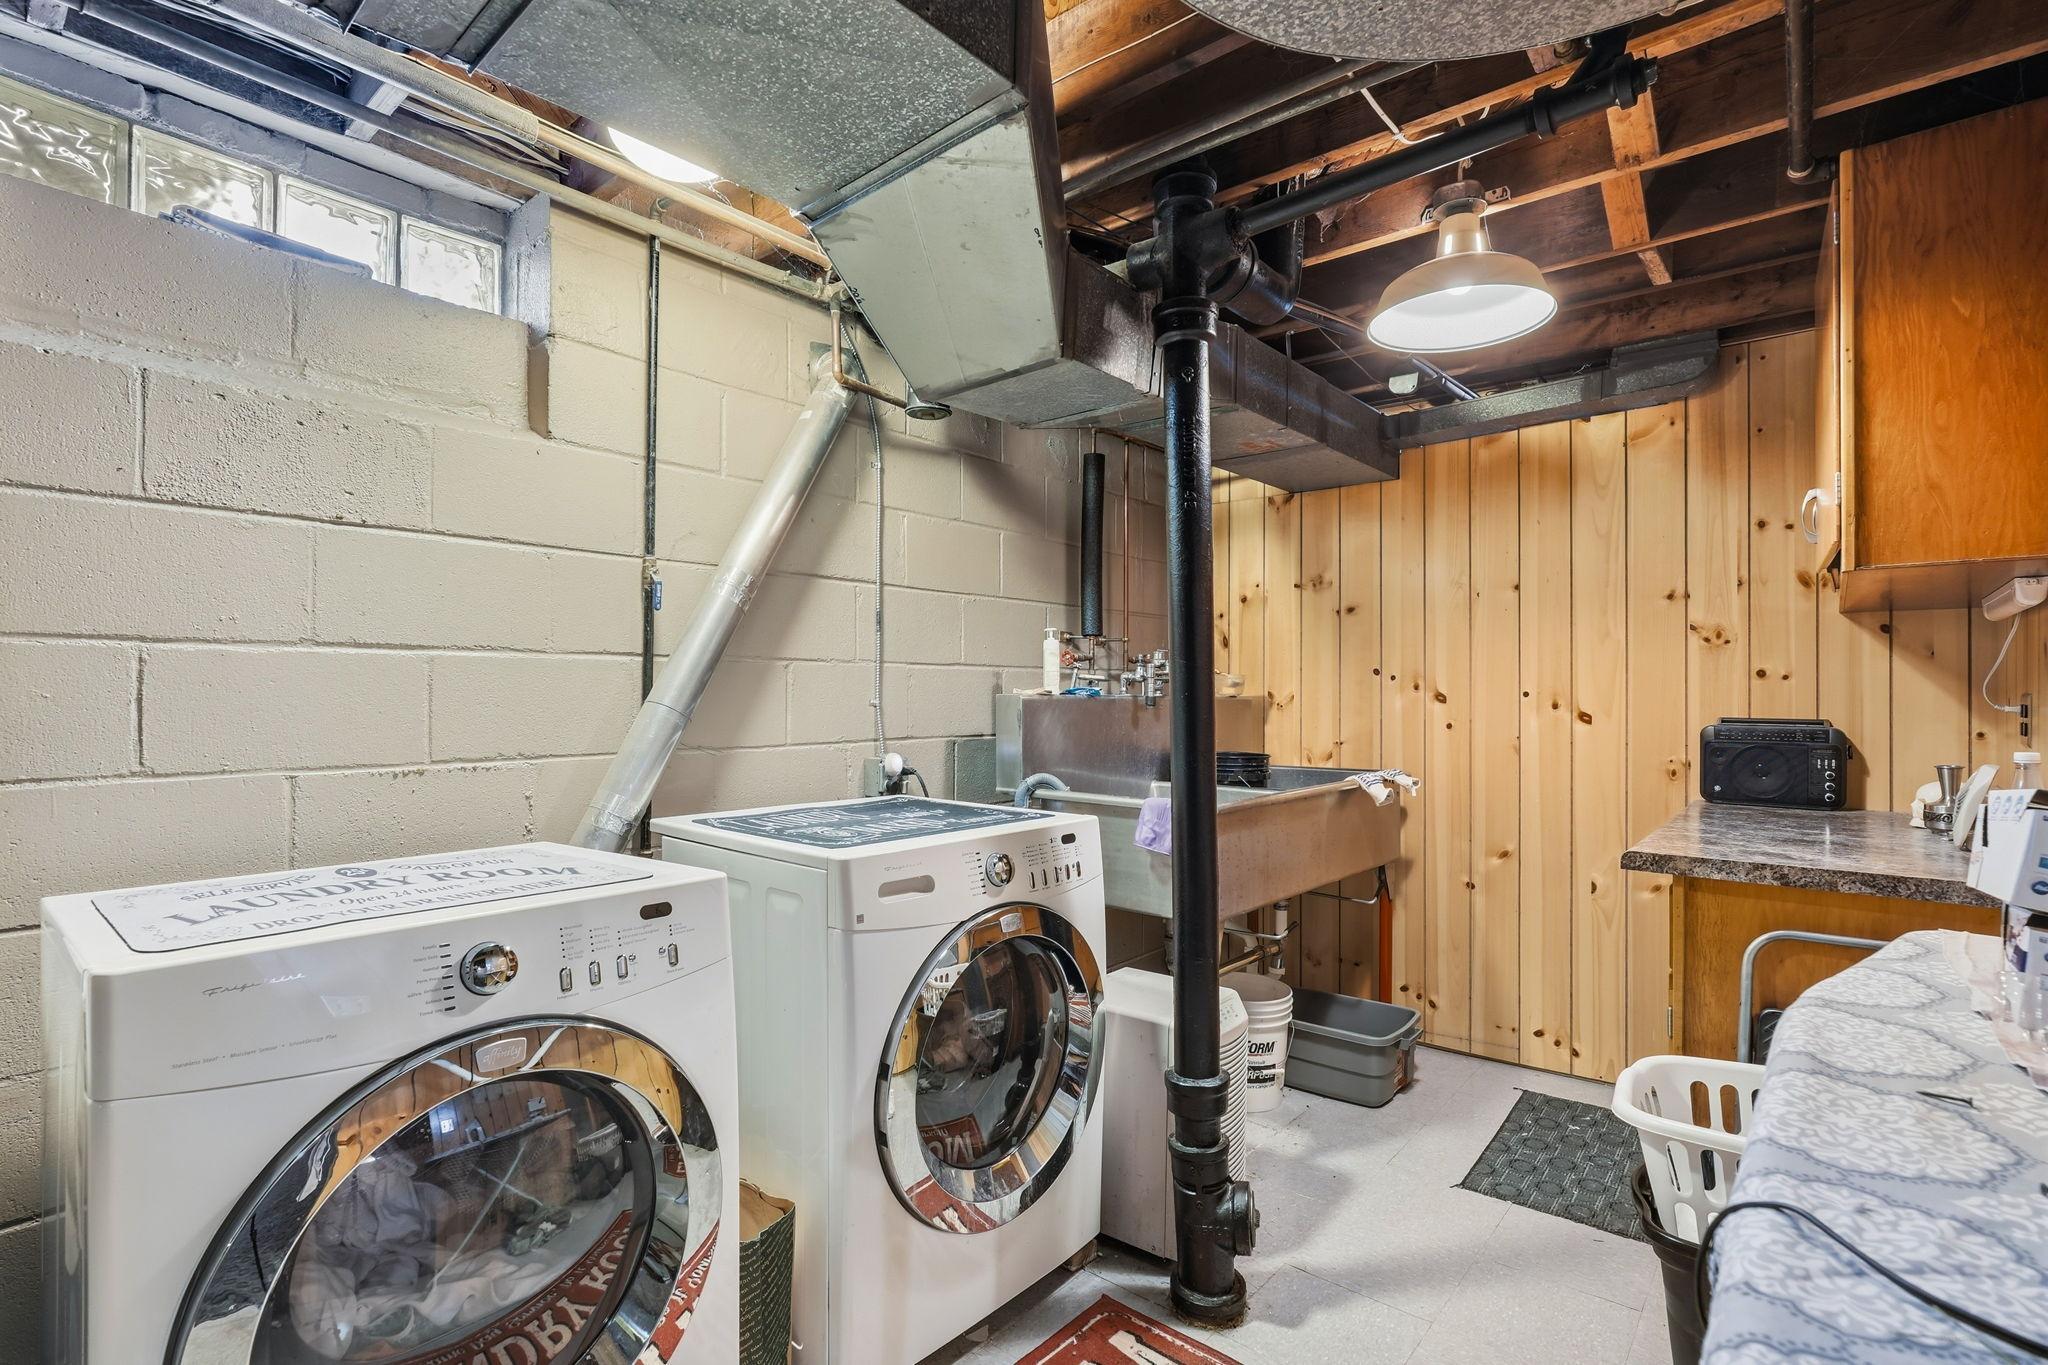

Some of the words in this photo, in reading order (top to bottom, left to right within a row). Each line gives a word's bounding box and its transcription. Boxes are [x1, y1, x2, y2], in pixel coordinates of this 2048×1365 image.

[164, 875, 415, 926] LAUNDRY
[420, 865, 583, 882] ROOM
[251, 913, 328, 930] DROP
[332, 901, 400, 918] YOUR
[404, 886, 511, 908] DRAWERS
[510, 877, 567, 892] HERE
[338, 893, 387, 905] Open
[391, 889, 409, 898] 24
[414, 883, 464, 895] hours
